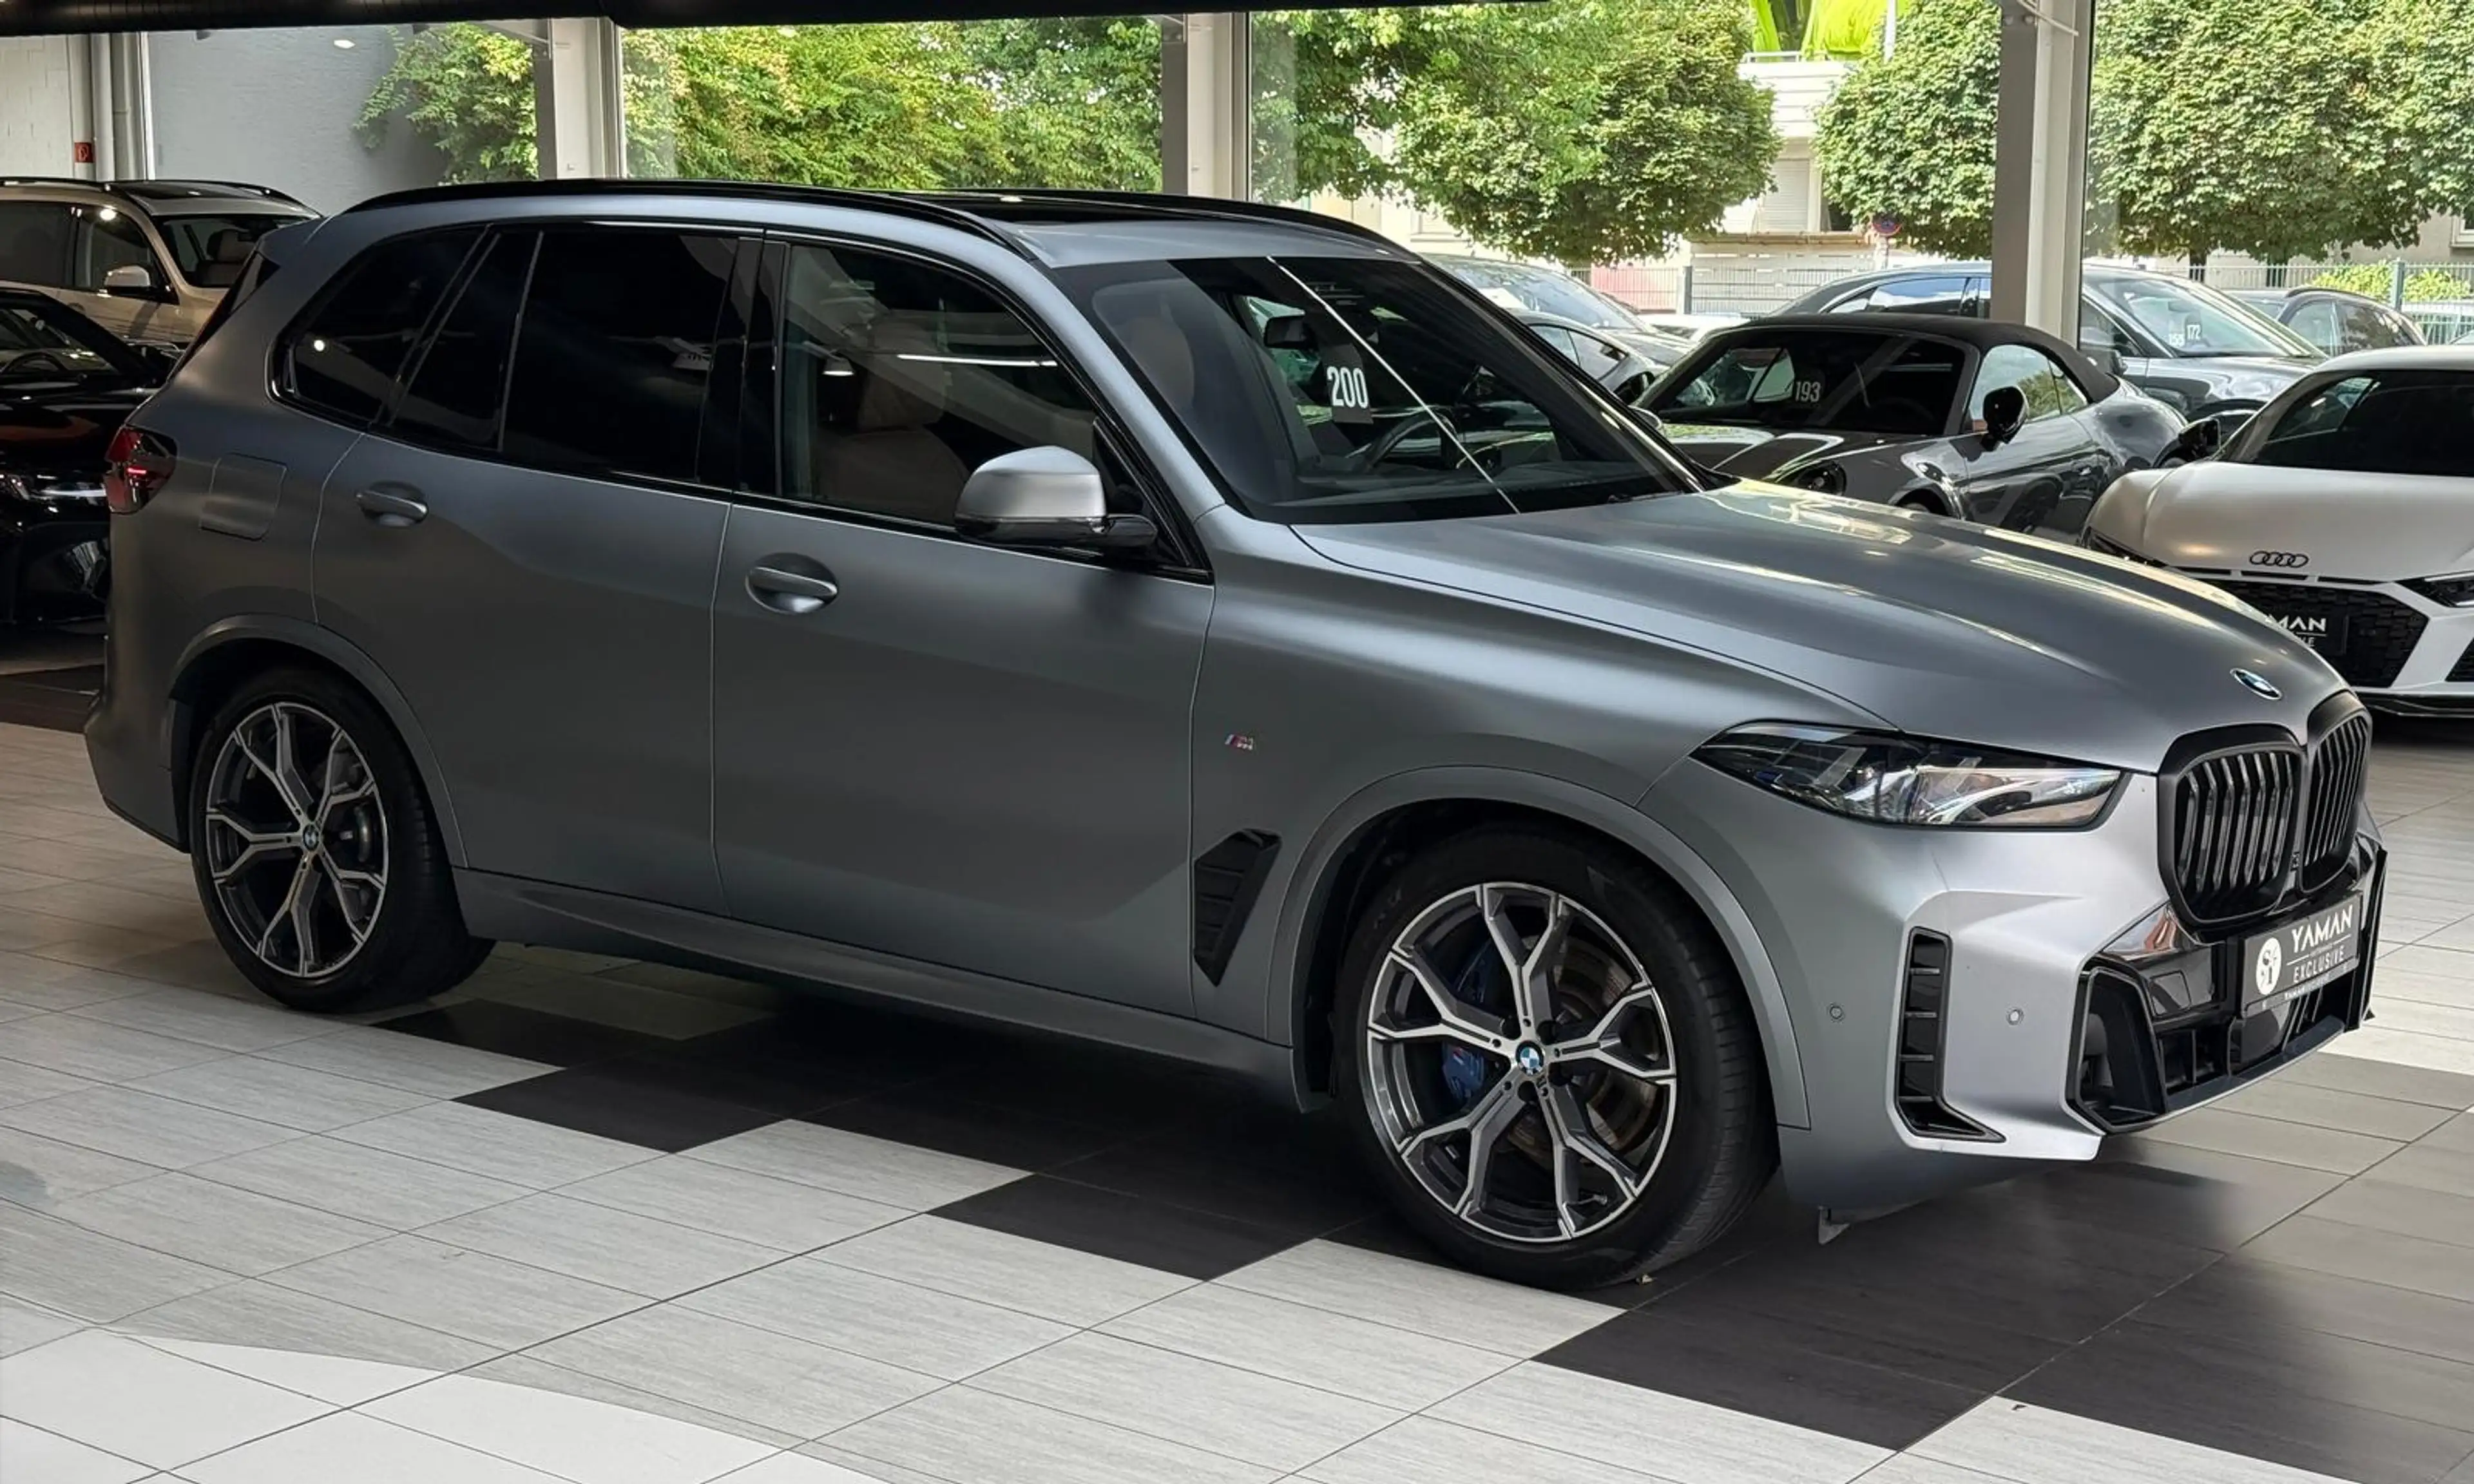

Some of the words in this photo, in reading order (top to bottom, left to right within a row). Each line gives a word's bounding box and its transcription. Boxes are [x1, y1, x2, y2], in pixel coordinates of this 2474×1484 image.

[2187, 324, 2201, 340] 172
[1327, 366, 1368, 408] 200
[1795, 381, 1821, 403] 193
[2268, 614, 2326, 632] MAN
[2292, 904, 2353, 953] YAMAN
[2293, 945, 2345, 983] EXCLUSIVE
